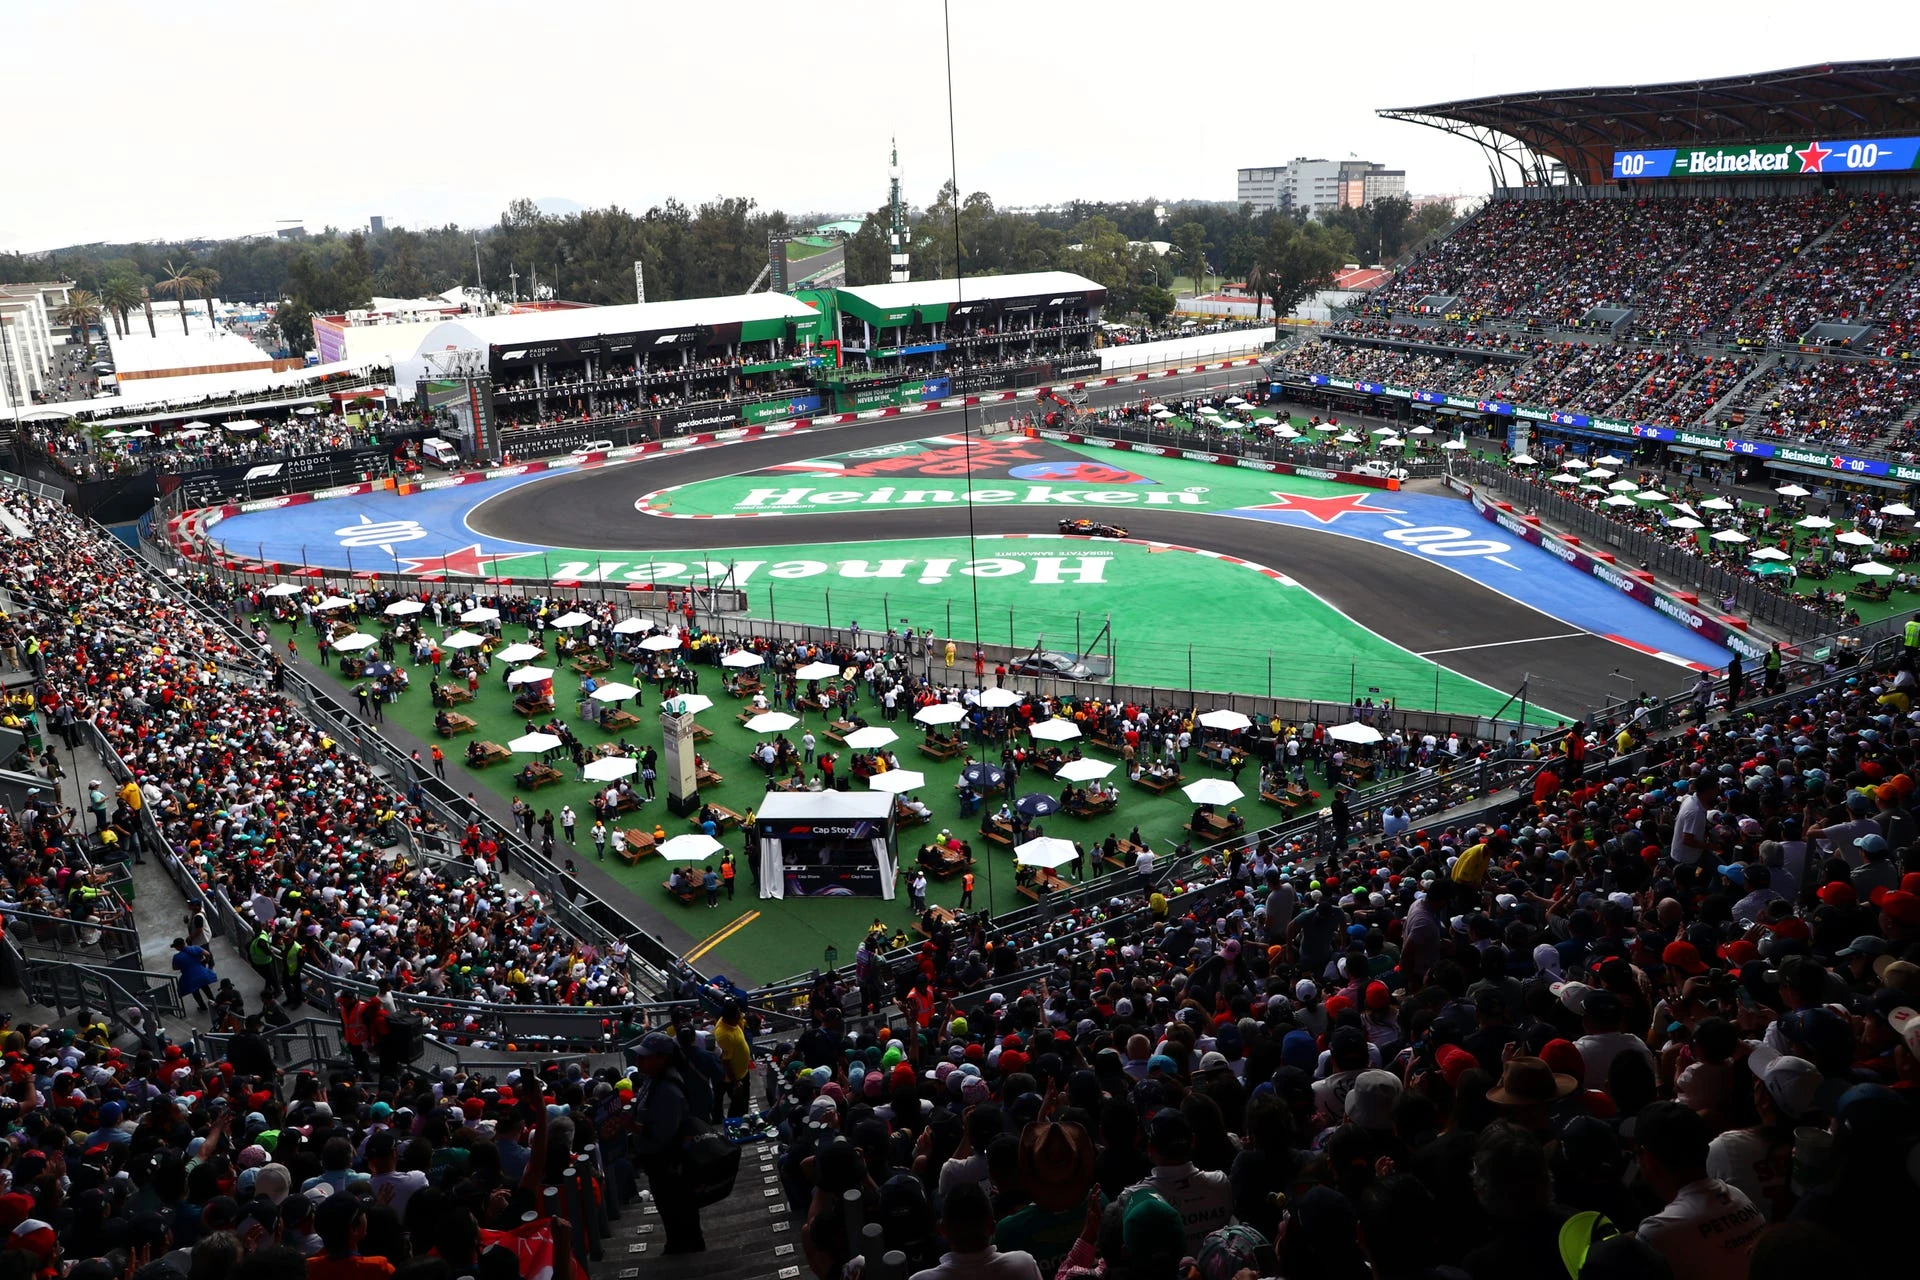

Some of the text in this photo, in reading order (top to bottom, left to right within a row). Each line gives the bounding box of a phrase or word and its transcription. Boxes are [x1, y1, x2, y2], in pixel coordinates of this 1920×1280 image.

[1688, 149, 1790, 173] Heineken
[509, 370, 728, 402] WHERE ADRENALINE MEETS ELEGANCE
[1447, 397, 1476, 408] Heineken
[1515, 406, 1548, 420] Heineken
[1592, 419, 1629, 434] Heineken
[1680, 433, 1722, 449] Heineken
[1780, 448, 1827, 466] Heineken
[287, 455, 331, 468] PADDOCK
[288, 465, 313, 474] CLUB
[1296, 468, 1337, 479] #MexicoGP
[241, 497, 290, 512] #MexicoGP
[313, 486, 361, 500] #MexicoGP
[1541, 536, 1577, 562] #MexicoGP
[550, 556, 1114, 587] Heineken
[1593, 563, 1634, 592] #MexicoGP
[1654, 595, 1703, 629] #MexicoGP
[812, 826, 830, 835] Cap
[831, 825, 856, 834] Store
[1182, 1206, 1225, 1226] RONAS
[1697, 1203, 1759, 1239] PETRON
